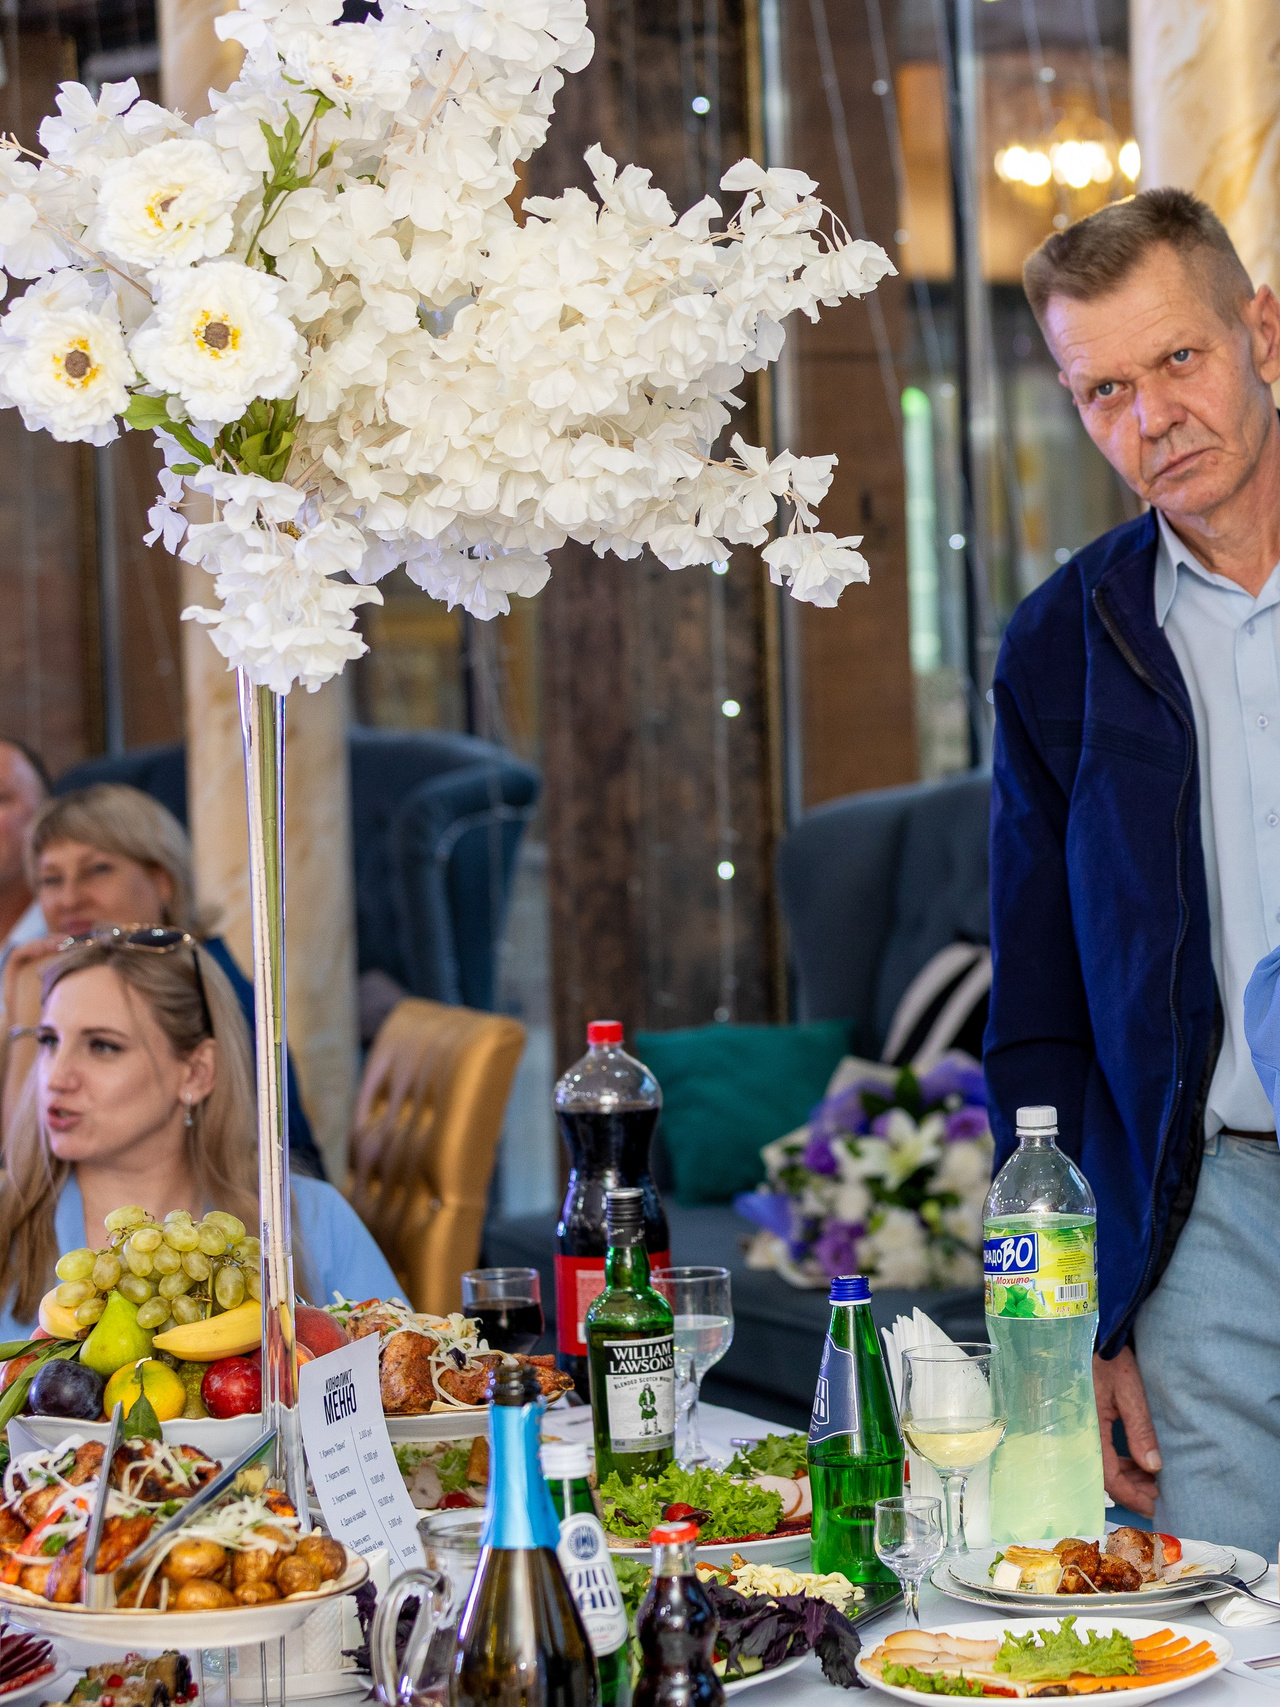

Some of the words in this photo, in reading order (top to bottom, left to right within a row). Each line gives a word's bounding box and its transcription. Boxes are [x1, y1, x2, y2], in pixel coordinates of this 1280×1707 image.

[996, 1276, 1030, 1285] Мохито
[612, 1342, 671, 1360] WILLIAM
[609, 1354, 674, 1374] LAWSON'S
[325, 1368, 353, 1394] КОНФЛИКТ
[613, 1379, 638, 1390] BLENDED
[323, 1382, 357, 1426] МЕНЮ
